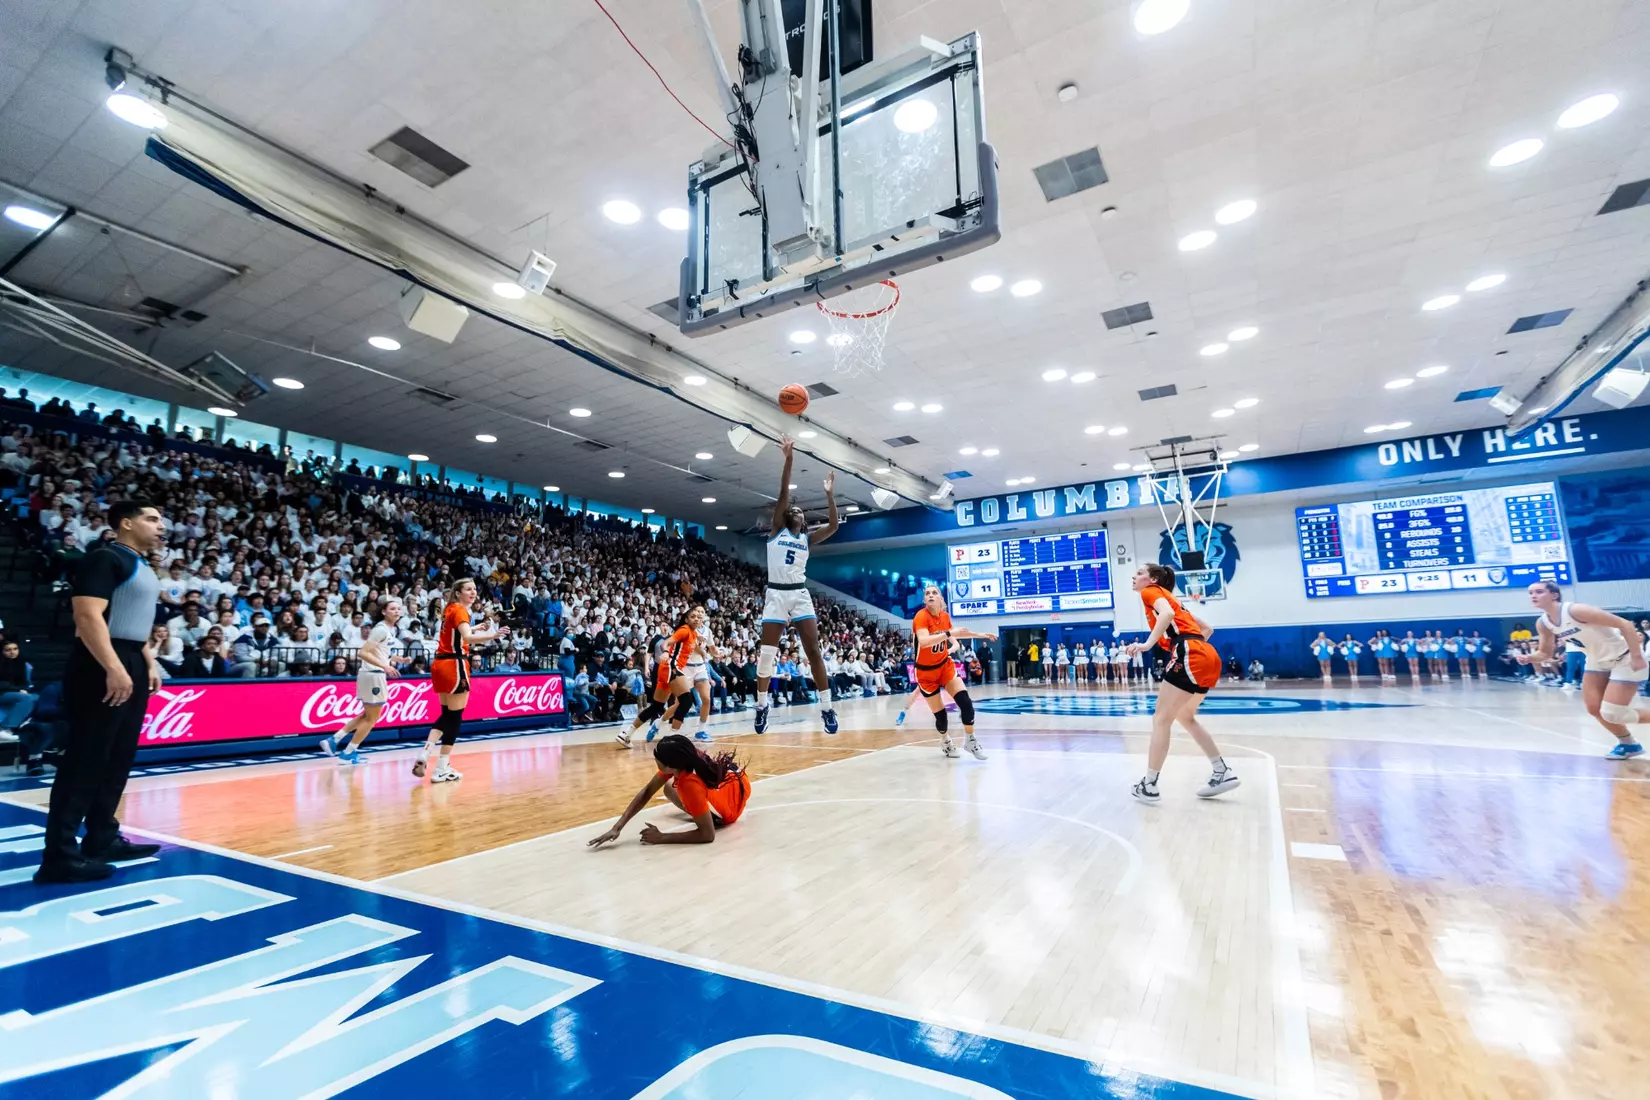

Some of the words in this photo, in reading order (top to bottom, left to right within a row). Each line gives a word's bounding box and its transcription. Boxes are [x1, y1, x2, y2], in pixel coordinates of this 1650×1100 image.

[1378, 434, 1463, 466] ONLY
[1372, 501, 1397, 510] TEAM
[1400, 495, 1463, 508] COMPARISON
[1401, 528, 1442, 538] REBOUNDS
[1406, 538, 1440, 548] ASSISTS
[785, 549, 796, 565] 5
[978, 549, 990, 557] 23
[1409, 548, 1439, 557] STEALS
[1403, 558, 1449, 567] TURNOVERS
[1381, 579, 1397, 588] 23
